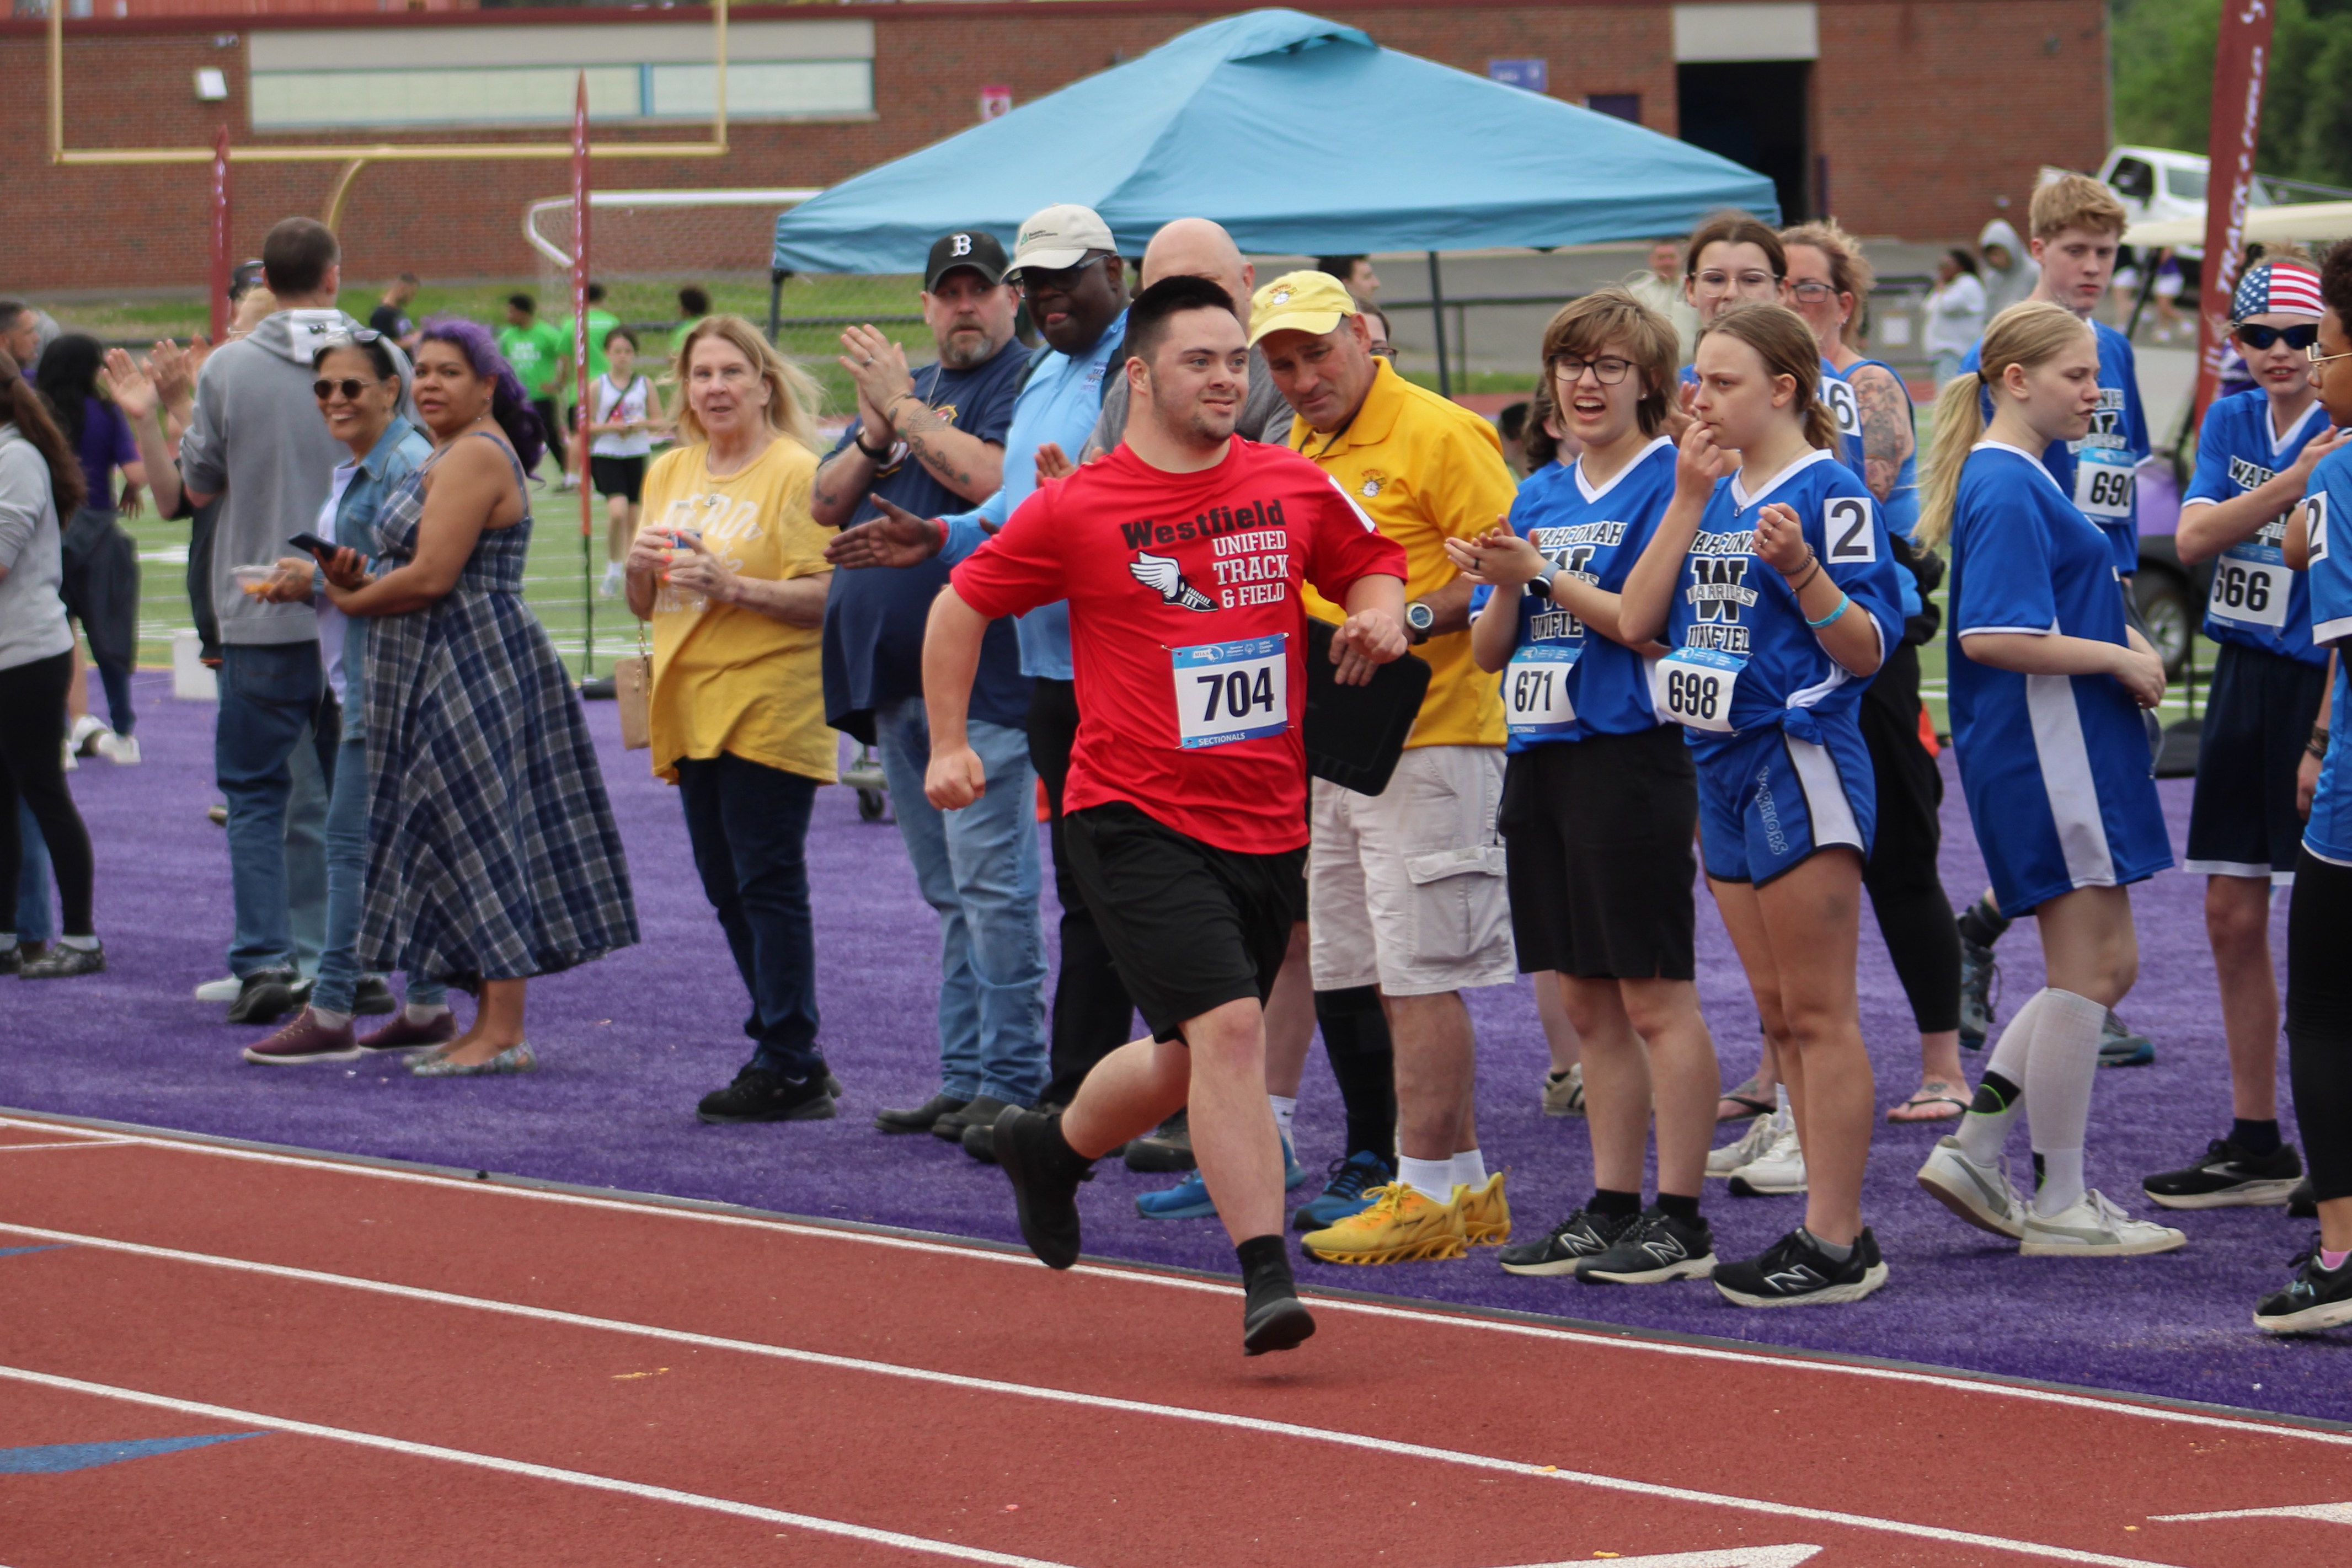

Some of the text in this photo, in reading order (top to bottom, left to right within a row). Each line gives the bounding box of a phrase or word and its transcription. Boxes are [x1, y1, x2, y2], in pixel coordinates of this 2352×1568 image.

[950, 234, 972, 258] B
[1829, 383, 1855, 430] 6
[1120, 499, 1286, 550] Westfield
[1212, 530, 1287, 556] UNIFIED
[1831, 500, 1869, 557] 2
[2306, 498, 2322, 555] 2
[1213, 554, 1290, 585] TRACK
[1691, 557, 1749, 623] W
[1221, 582, 1286, 608] & FIELD
[1531, 611, 1584, 641] UNIFIE
[1197, 666, 1275, 723] 704
[1515, 670, 1554, 712] 671
[1669, 670, 1720, 720] 698
[1198, 732, 1246, 746] SECTIONALS
[1756, 766, 1788, 854] WARRIORS
